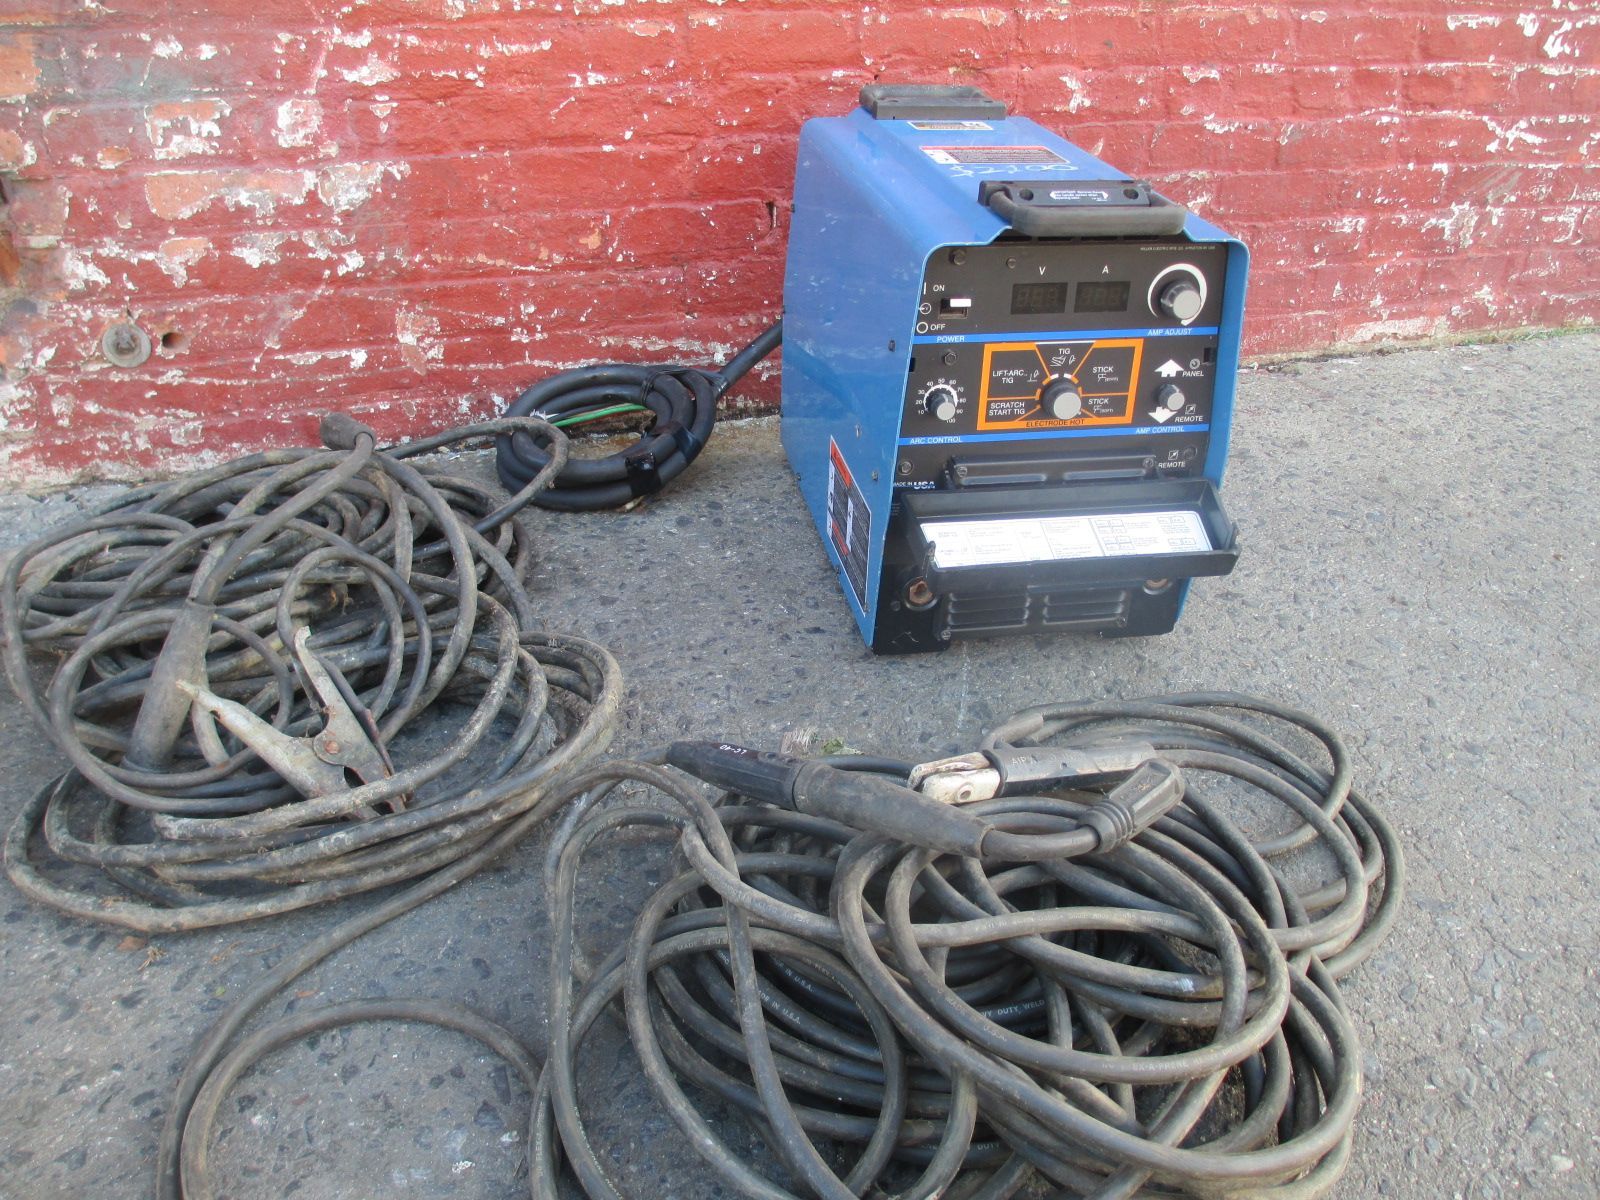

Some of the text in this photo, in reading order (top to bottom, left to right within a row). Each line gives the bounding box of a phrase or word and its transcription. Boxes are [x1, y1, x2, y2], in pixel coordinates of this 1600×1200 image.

[1039, 266, 1046, 275] V
[1102, 265, 1109, 274] A
[930, 323, 946, 331] OFF
[936, 335, 965, 343] POWER
[1092, 366, 1114, 374] STICK
[1174, 415, 1203, 423] REMOTE
[1026, 420, 1067, 428] ELECTRODE
[927, 436, 962, 444] CONTROL
[1158, 461, 1186, 469] REMOTE
[913, 481, 936, 489] USA
[997, 1005, 1018, 1016] DUTY
